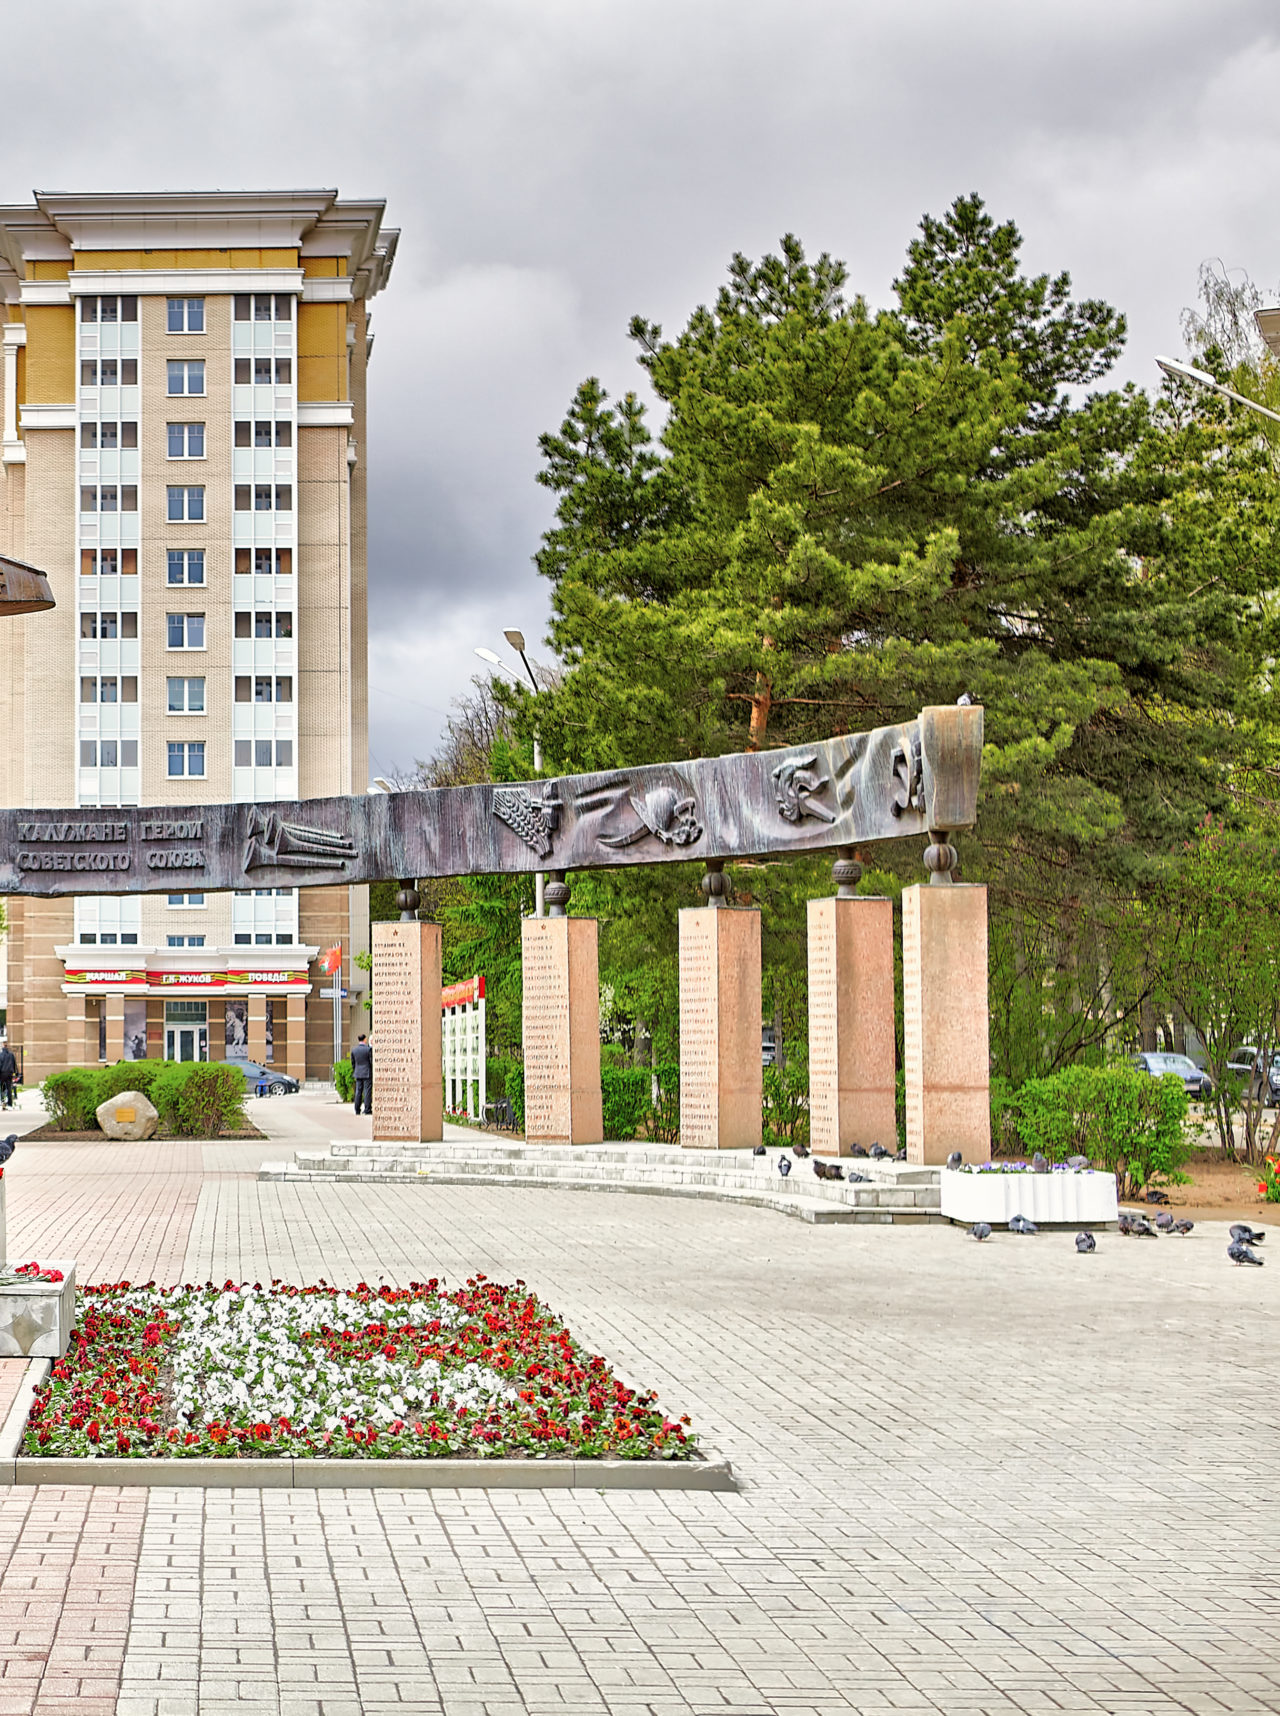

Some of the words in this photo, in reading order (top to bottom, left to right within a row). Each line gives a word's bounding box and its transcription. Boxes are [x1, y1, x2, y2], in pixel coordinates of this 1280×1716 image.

[18, 823, 127, 842] КАЛУЖАНЕ
[140, 822, 203, 841] ГЕРОИ
[18, 852, 131, 872] СОВЕТСКОГО
[146, 849, 206, 870] СОЮЗА
[86, 972, 126, 981] МАРШАЛ
[180, 974, 212, 984] ЖУКОВ
[248, 972, 288, 983] ПОБЕДЫ
